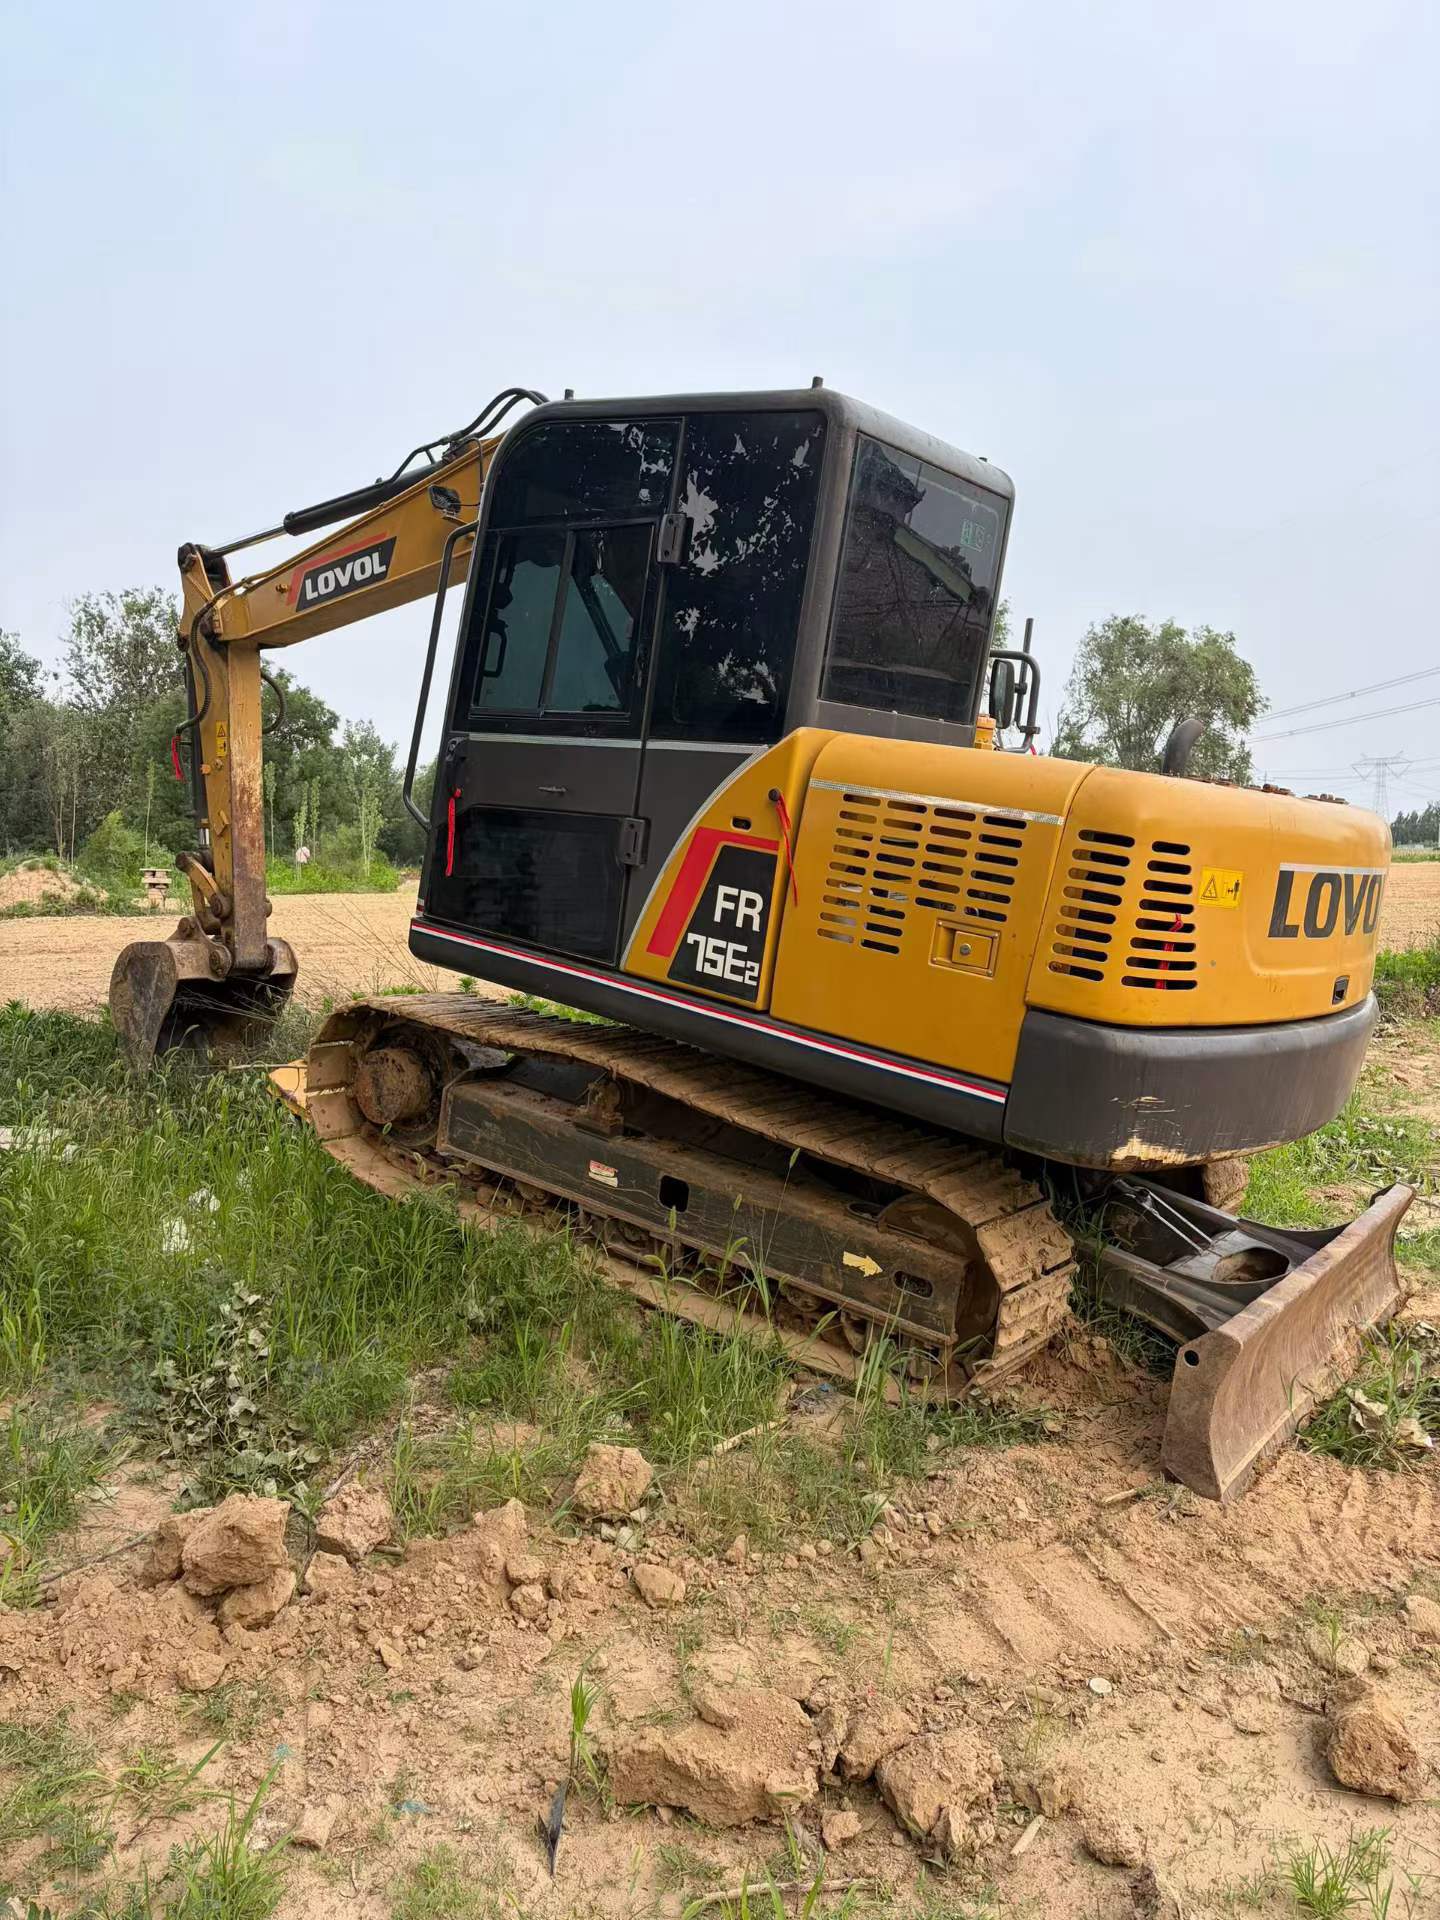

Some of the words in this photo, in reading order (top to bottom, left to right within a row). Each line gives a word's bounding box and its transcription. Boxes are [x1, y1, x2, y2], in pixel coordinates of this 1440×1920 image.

[305, 552, 387, 600] LOVOL
[713, 885, 764, 932] FR
[1268, 870, 1384, 938] LOVO
[687, 932, 760, 986] 75E2
